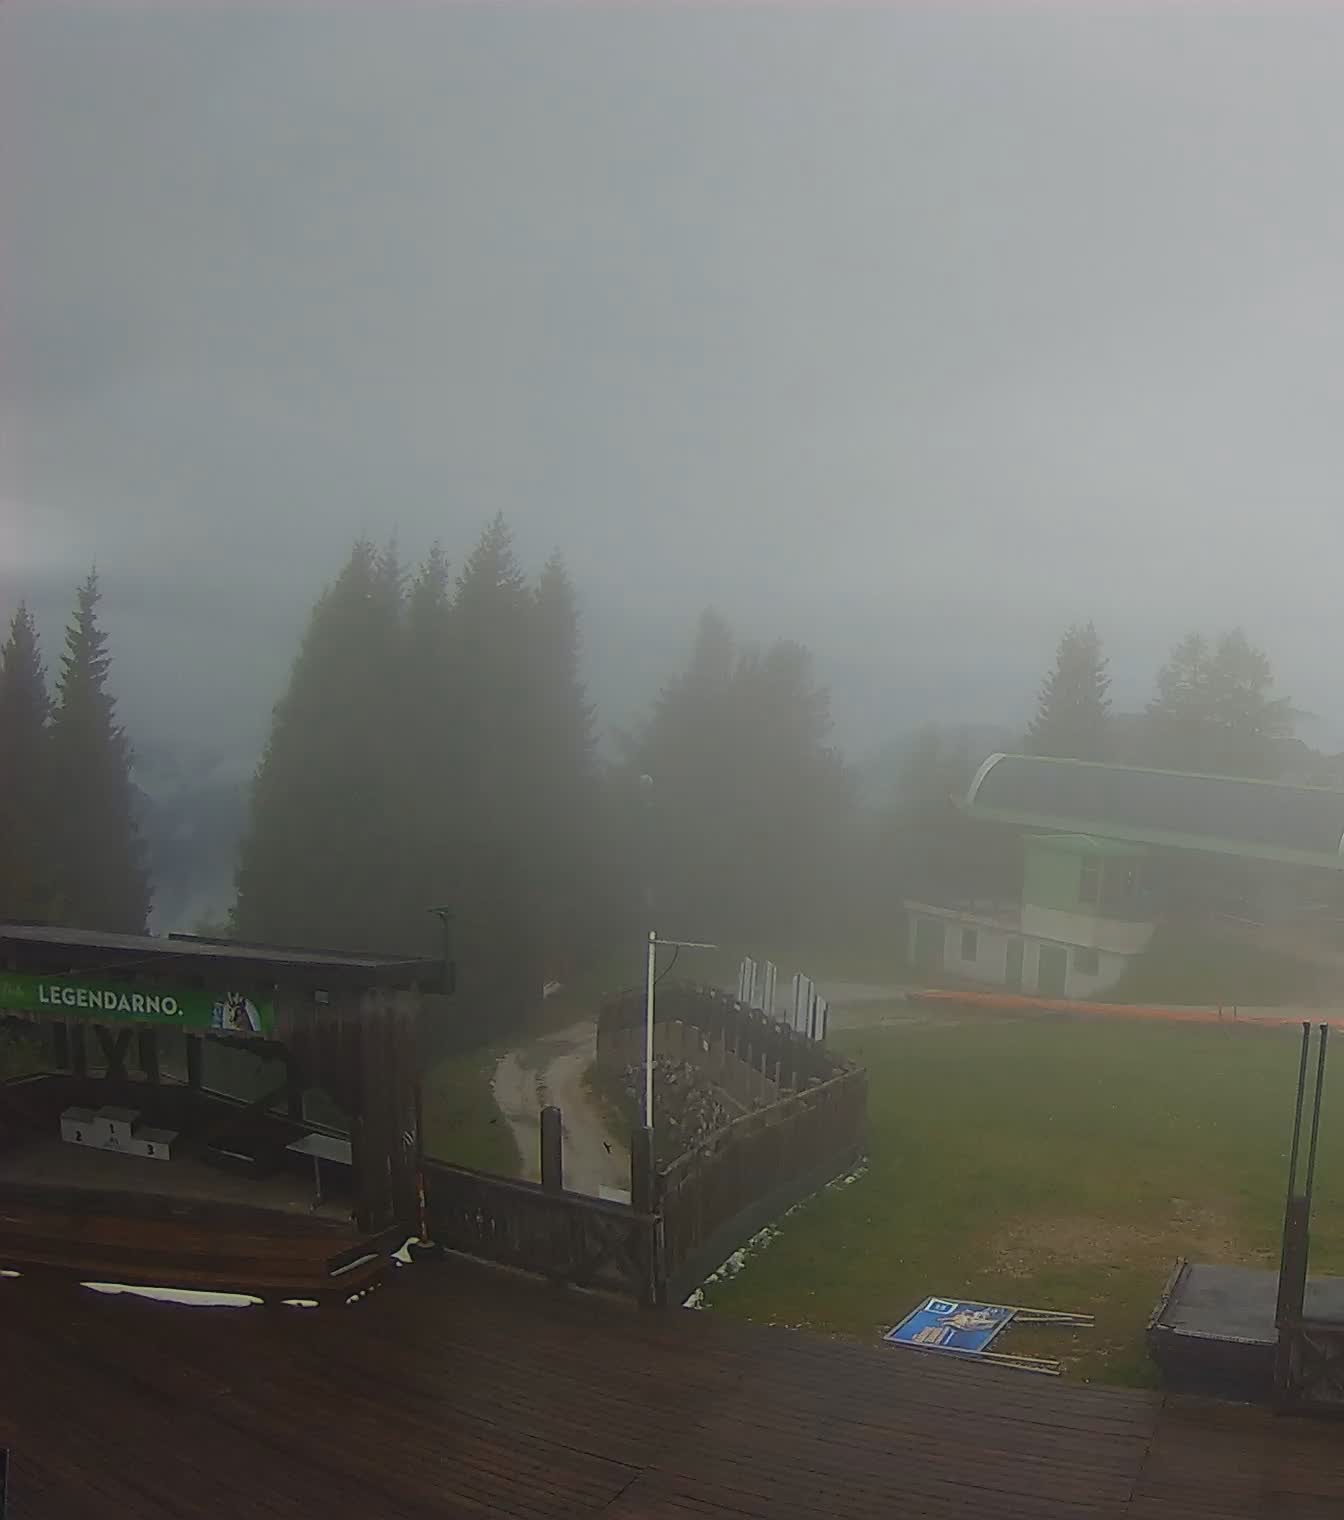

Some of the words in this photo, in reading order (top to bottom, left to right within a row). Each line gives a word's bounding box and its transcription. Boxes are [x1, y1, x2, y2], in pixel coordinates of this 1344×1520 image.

[38, 984, 184, 1017] LEGENDARNO.
[75, 1129, 83, 1142] 2
[146, 1143, 155, 1156] 3
